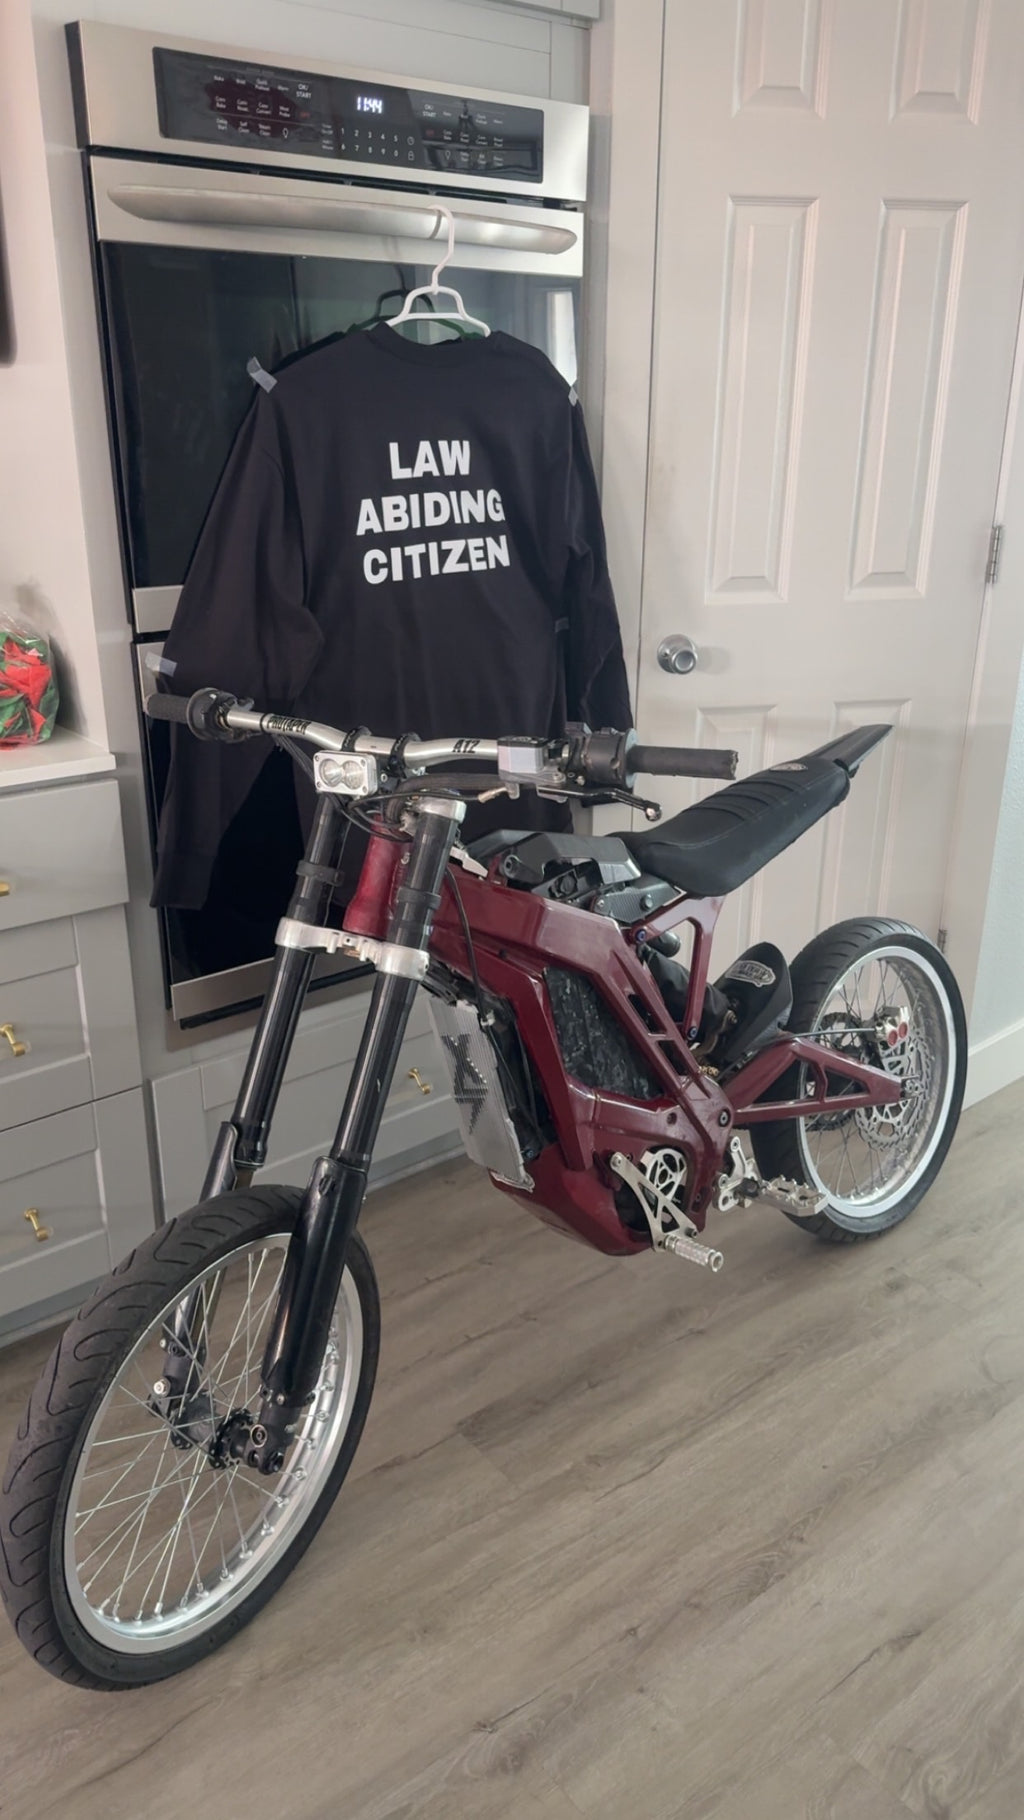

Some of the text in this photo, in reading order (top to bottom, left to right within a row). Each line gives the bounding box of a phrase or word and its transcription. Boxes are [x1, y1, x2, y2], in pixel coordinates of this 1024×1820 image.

[296, 91, 312, 99] START
[356, 96, 383, 115] 11:44
[389, 440, 470, 480] LAW
[356, 488, 506, 536] ABIDING
[363, 534, 510, 585] CITIZEN
